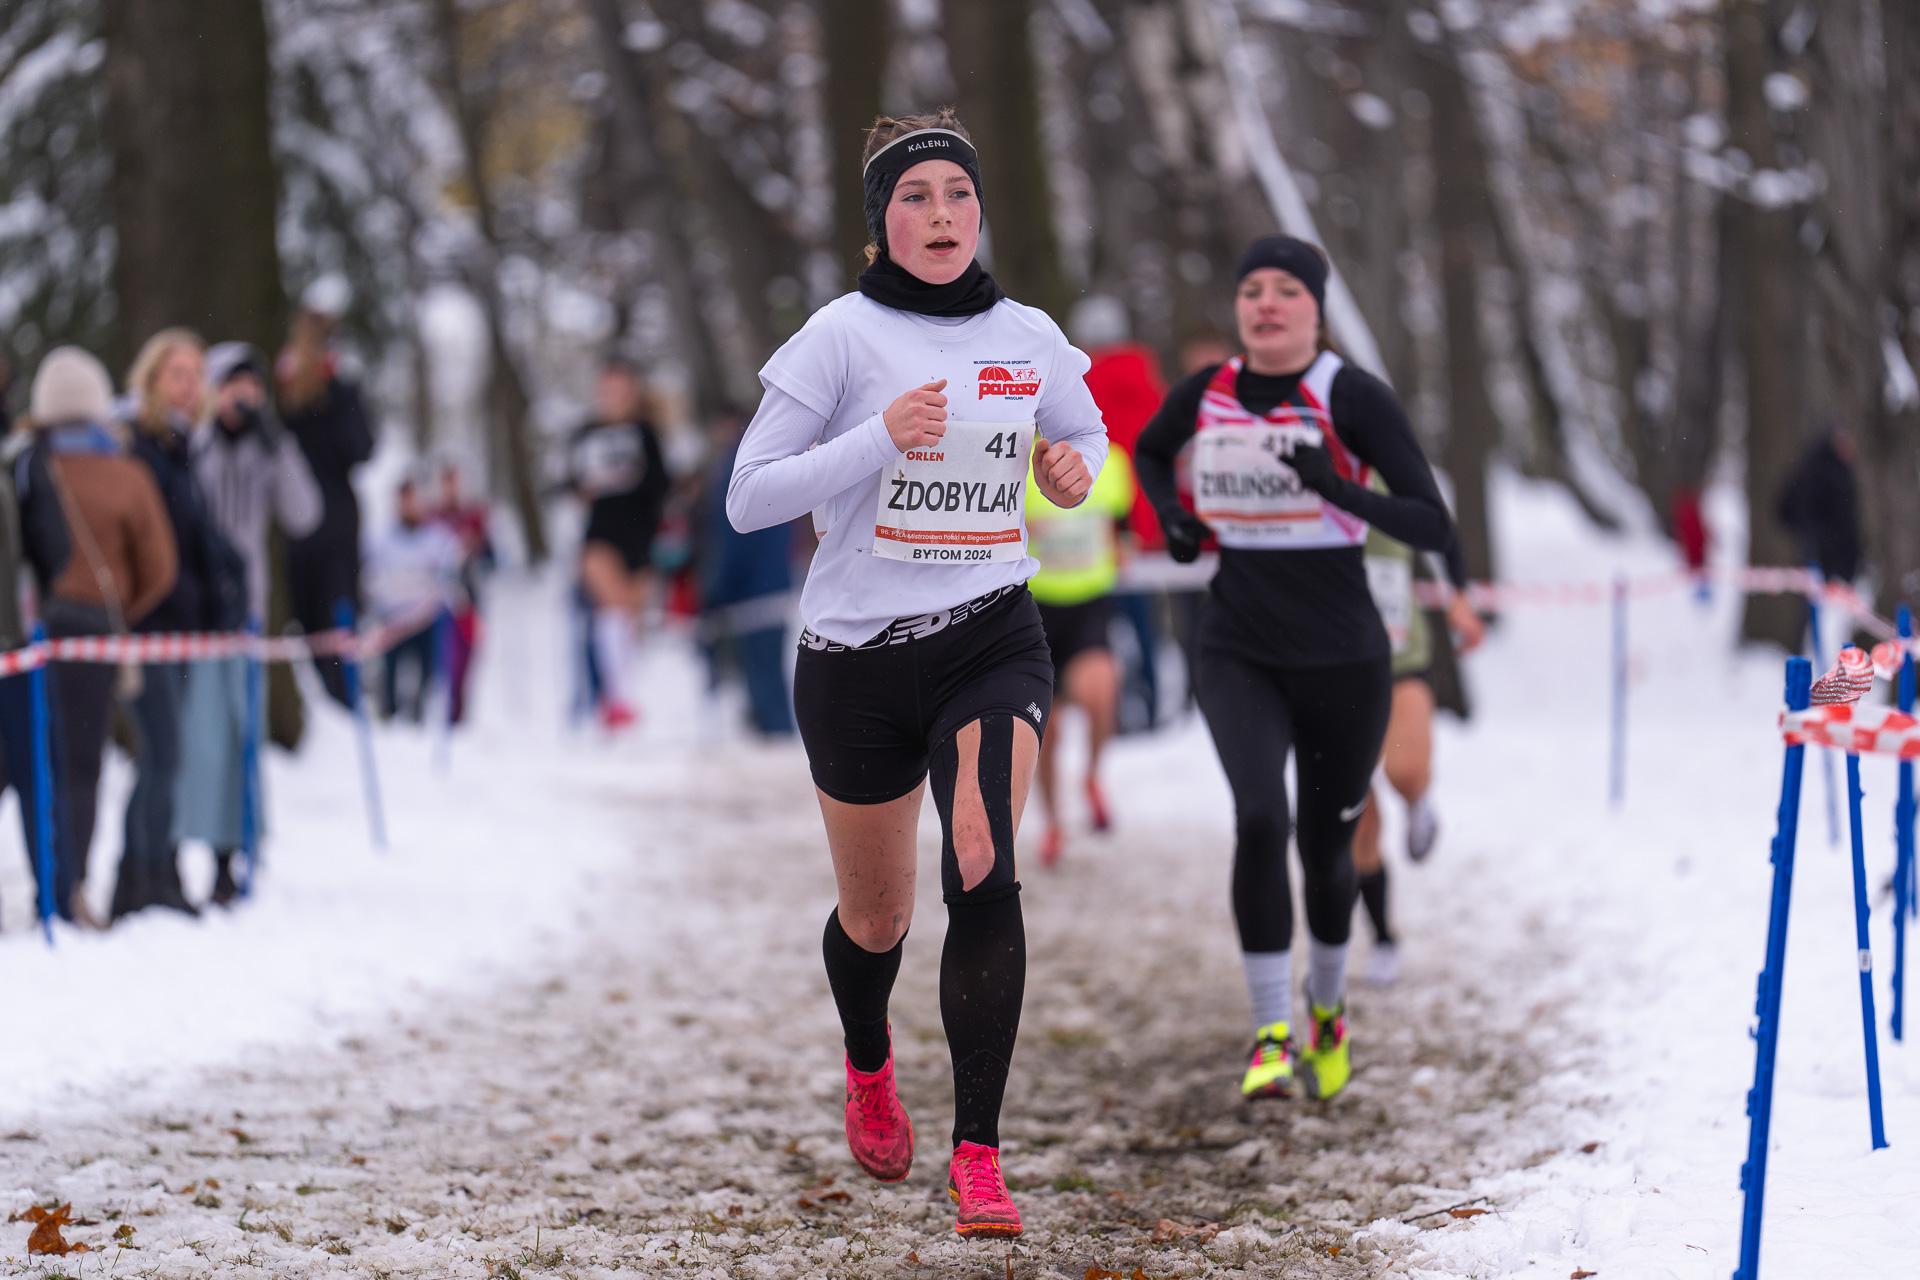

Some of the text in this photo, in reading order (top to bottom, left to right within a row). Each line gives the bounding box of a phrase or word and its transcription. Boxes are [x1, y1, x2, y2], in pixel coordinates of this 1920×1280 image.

[908, 140, 950, 152] KALENJI
[985, 432, 1017, 459] 41
[906, 451, 945, 462] ORLEN
[1201, 467, 1312, 498] ZIELIŃSK
[967, 534, 990, 542] Biegach
[913, 549, 992, 560] BYTOM 2024
